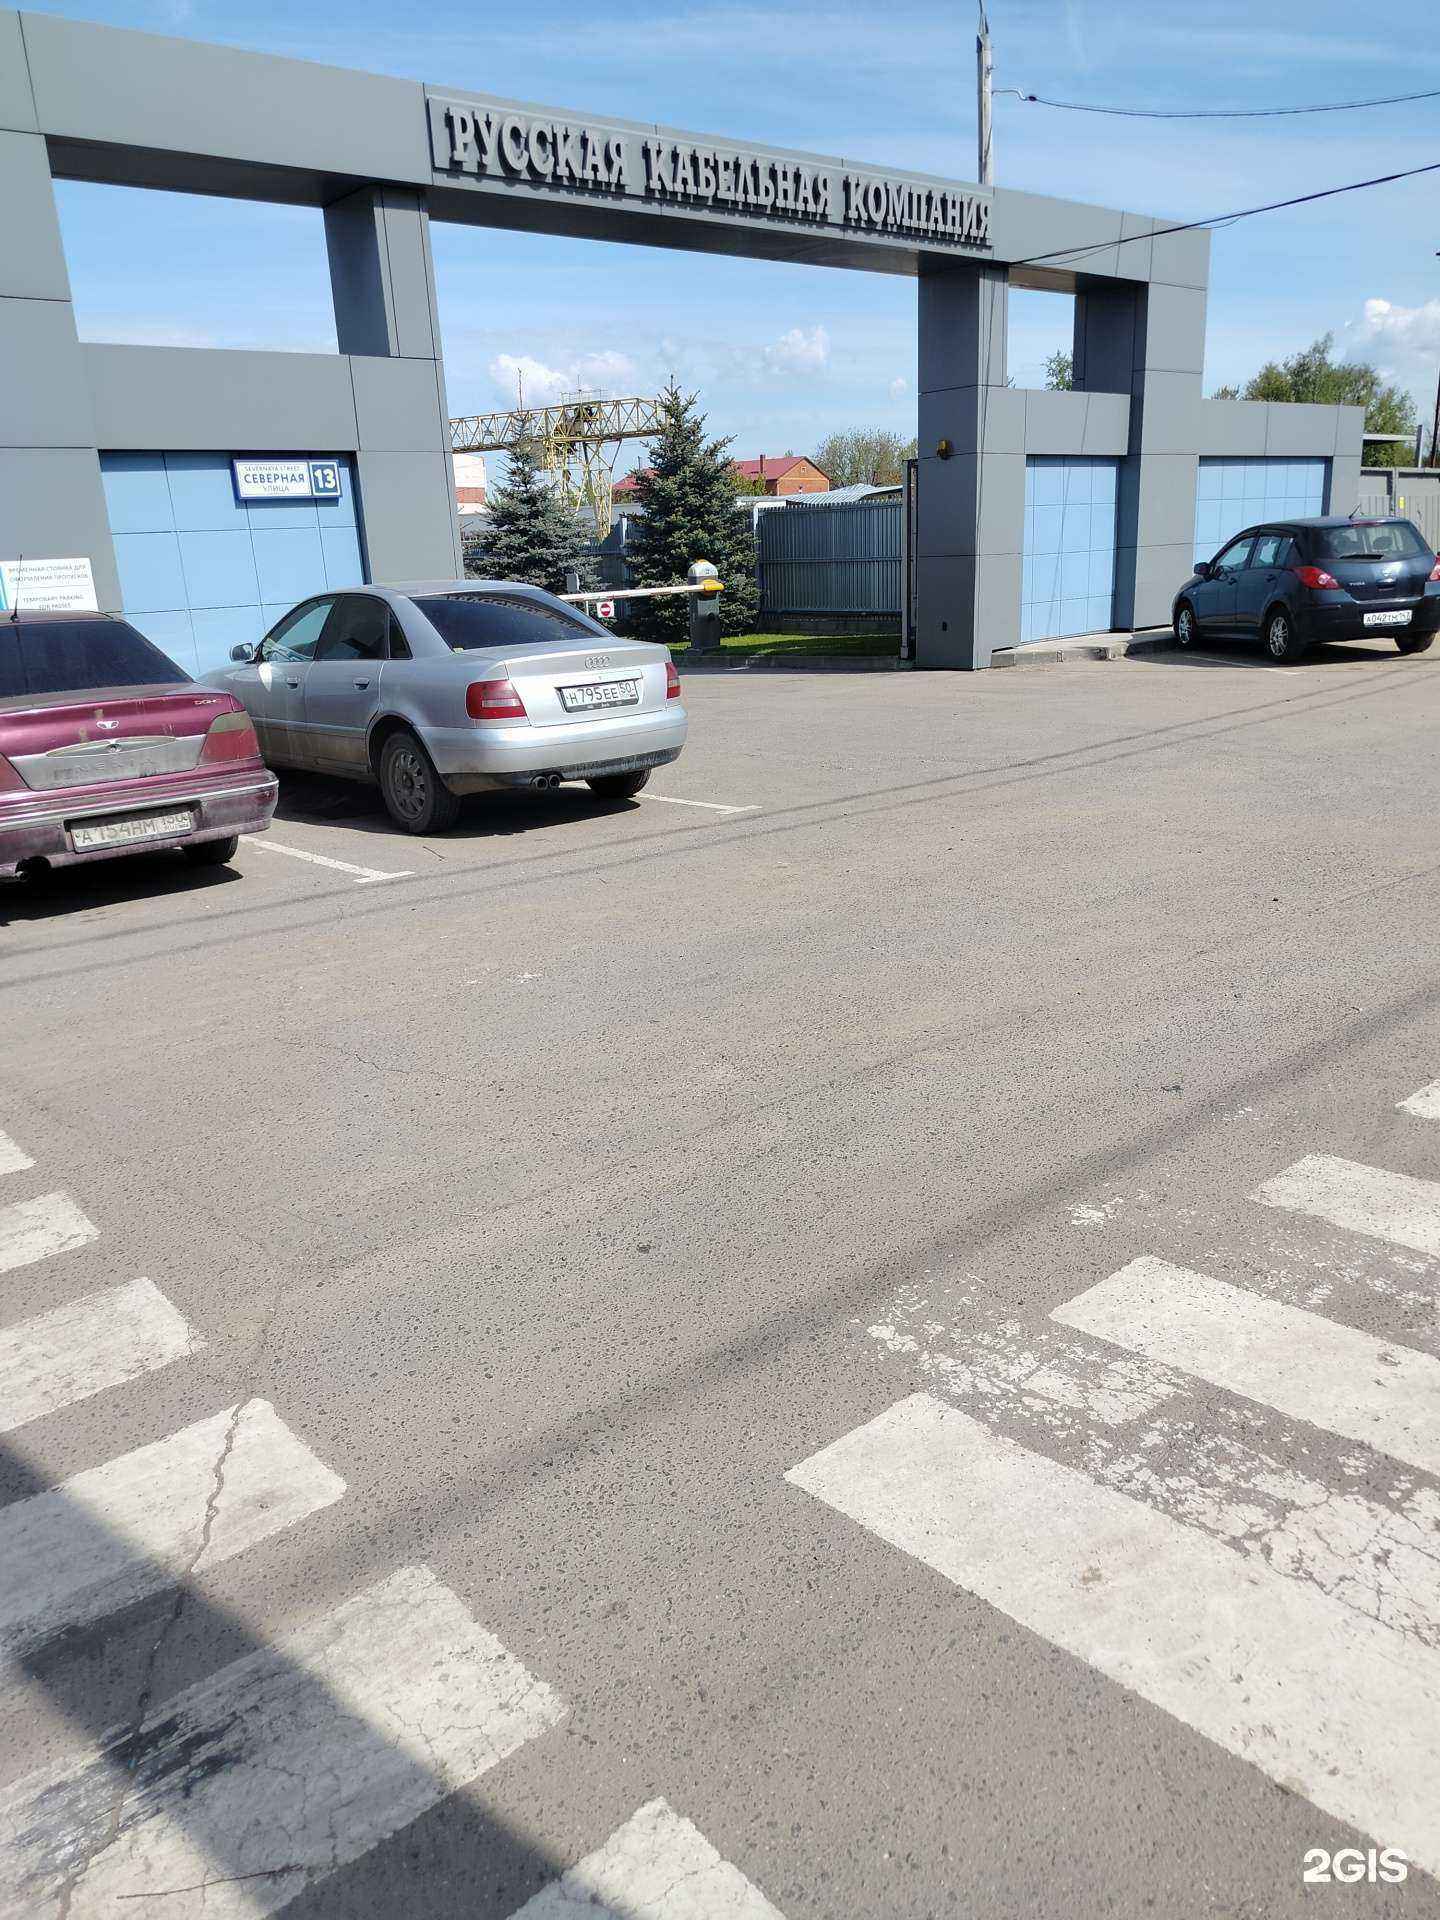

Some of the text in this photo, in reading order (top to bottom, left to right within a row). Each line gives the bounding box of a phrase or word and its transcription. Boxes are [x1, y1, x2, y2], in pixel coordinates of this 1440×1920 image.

[448, 106, 992, 240] РУССКАЯ КАБЕЛЬНАЯ КОМПАНИЯ
[244, 473, 305, 484] СЕВЕРНАЯ
[314, 468, 337, 490] 13
[263, 485, 290, 493] УЛИЦА
